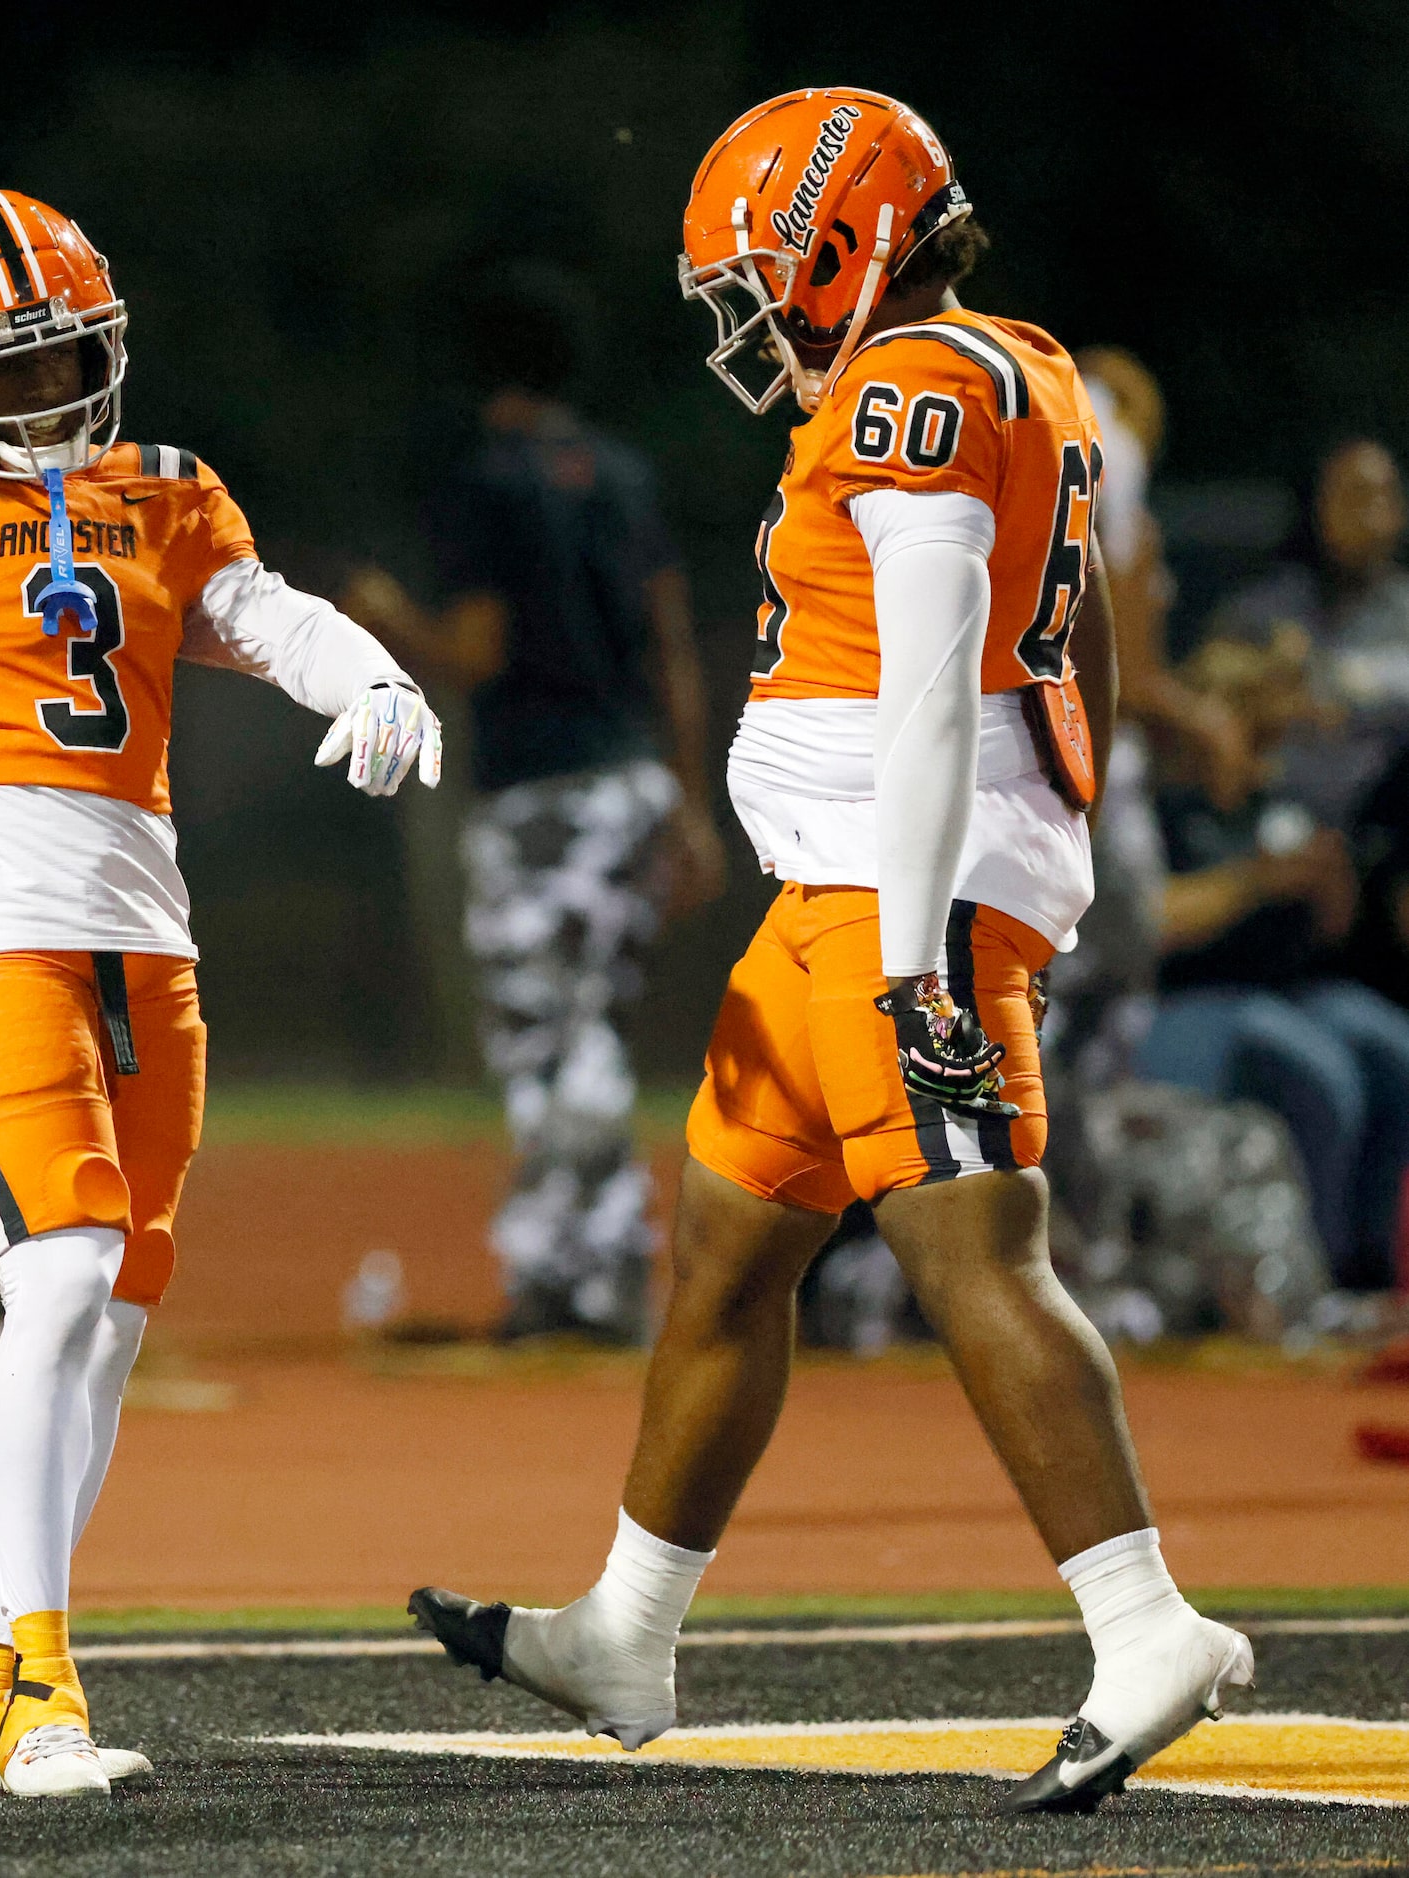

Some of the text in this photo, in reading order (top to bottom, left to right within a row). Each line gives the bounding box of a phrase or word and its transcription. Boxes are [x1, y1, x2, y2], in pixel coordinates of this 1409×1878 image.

[770, 104, 862, 258] Lancaster
[14, 307, 47, 324] schutt
[851, 380, 965, 469] 60
[21, 560, 132, 754] 3
